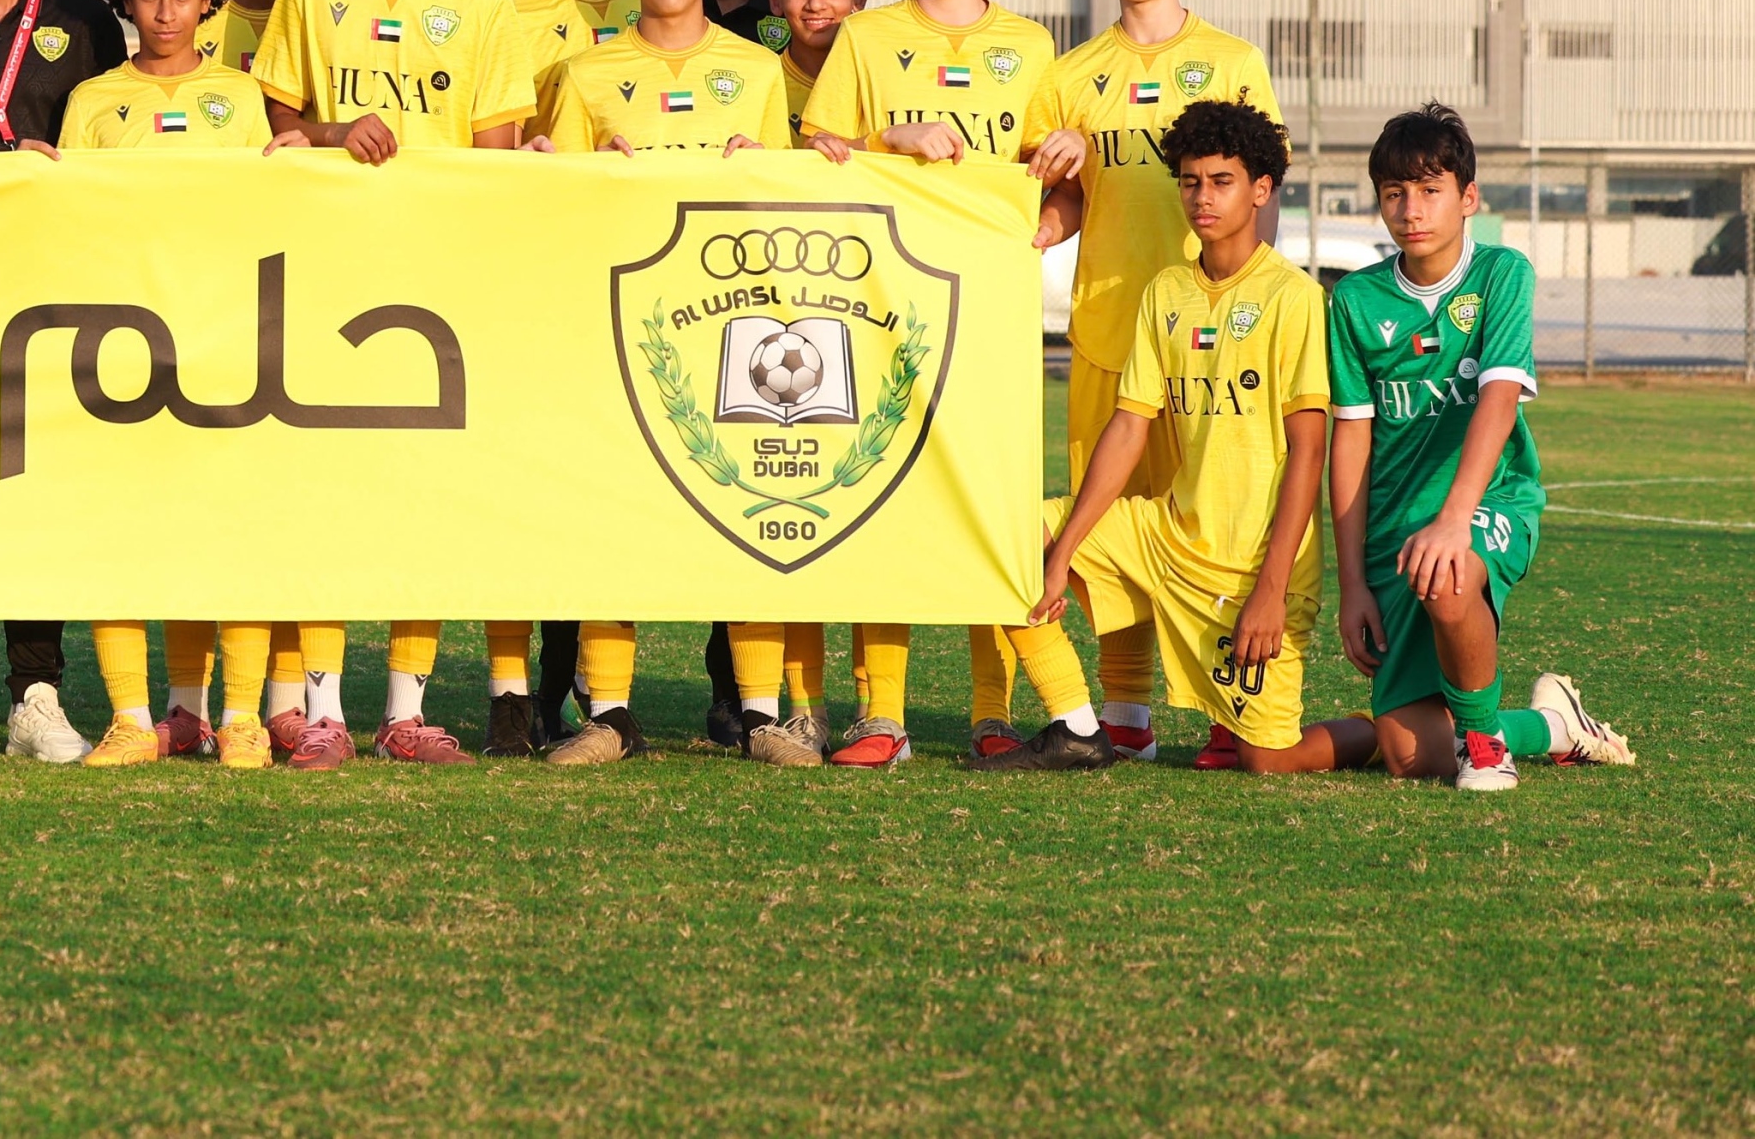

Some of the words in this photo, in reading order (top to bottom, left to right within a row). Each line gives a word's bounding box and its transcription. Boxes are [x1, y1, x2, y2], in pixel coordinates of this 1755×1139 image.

[328, 66, 430, 113] HUNA
[1090, 127, 1170, 168] HUN
[702, 285, 781, 316] WASL
[791, 286, 899, 332] الوصل
[0, 250, 467, 480] حلم
[753, 461, 819, 478] DUBAI
[754, 438, 819, 460] دبي
[759, 521, 817, 541] 1960
[1213, 635, 1266, 695] 30
